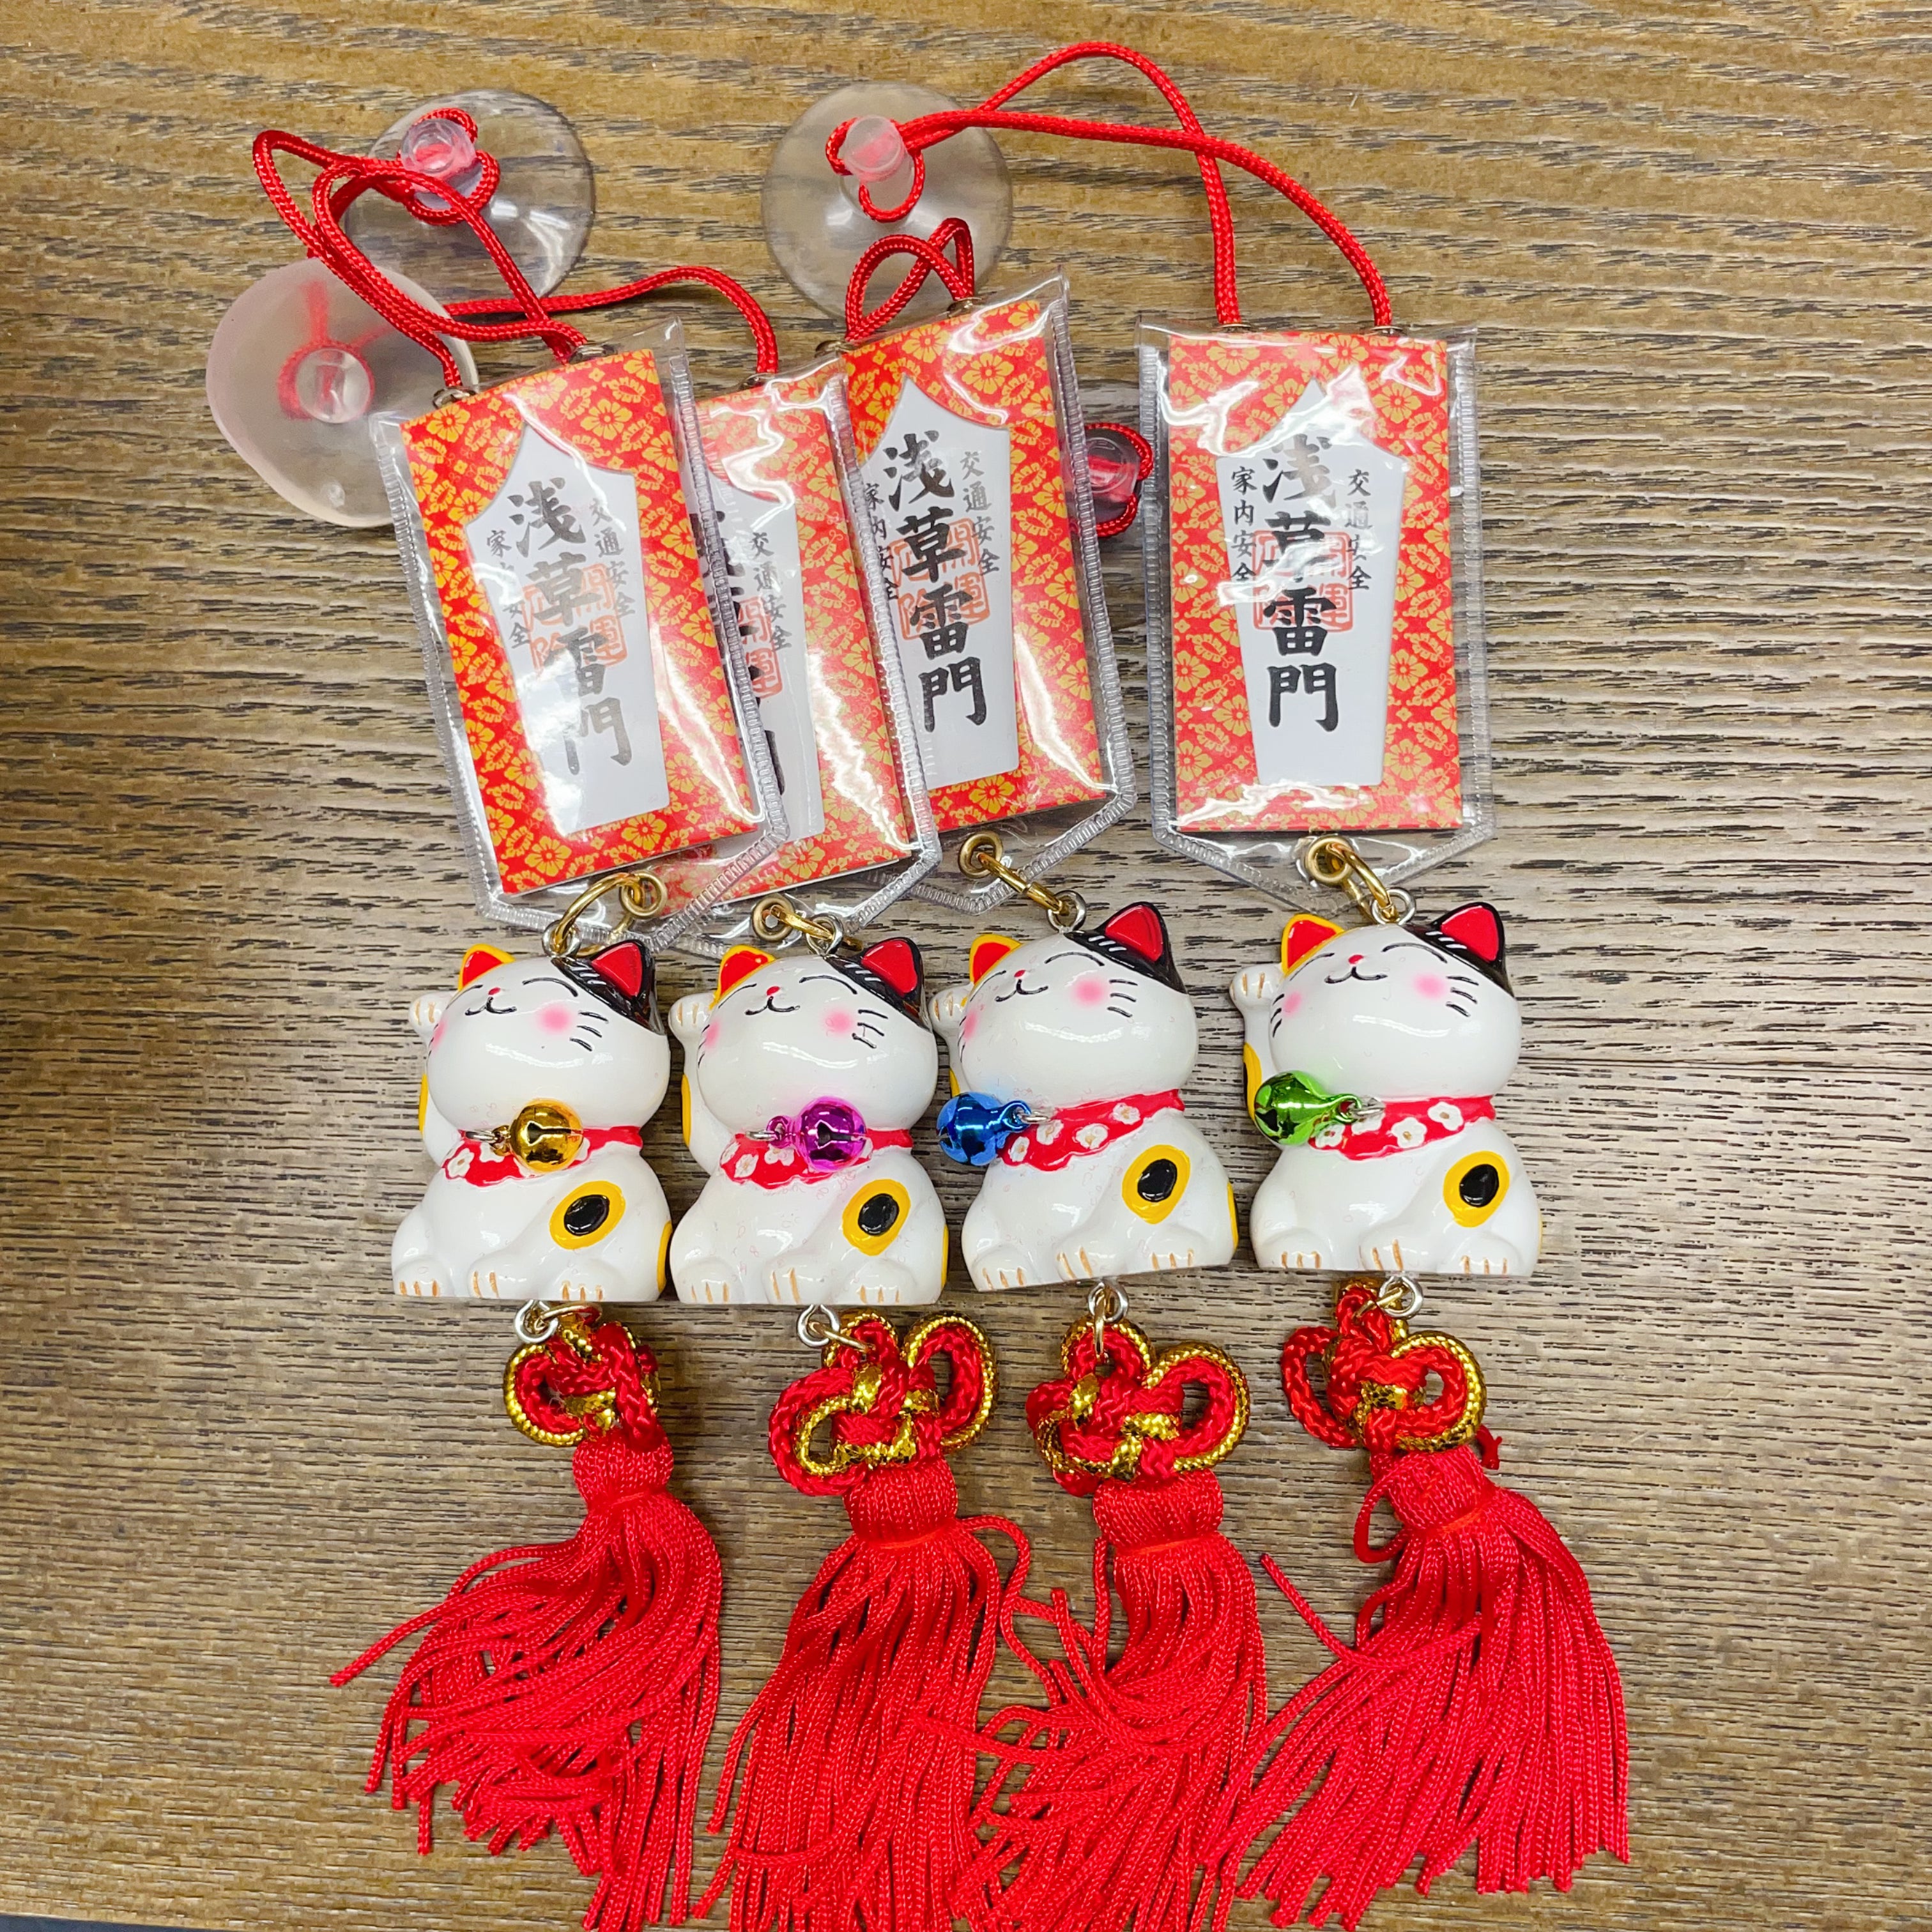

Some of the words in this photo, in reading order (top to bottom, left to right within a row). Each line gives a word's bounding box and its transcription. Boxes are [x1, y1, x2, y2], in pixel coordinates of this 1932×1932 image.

[588, 497, 637, 618] 交通安全
[960, 451, 1001, 576] 交通安全
[1230, 466, 1258, 583] 家内安全
[507, 477, 632, 776] 浅草雷門
[883, 429, 988, 732] 浅草雷門
